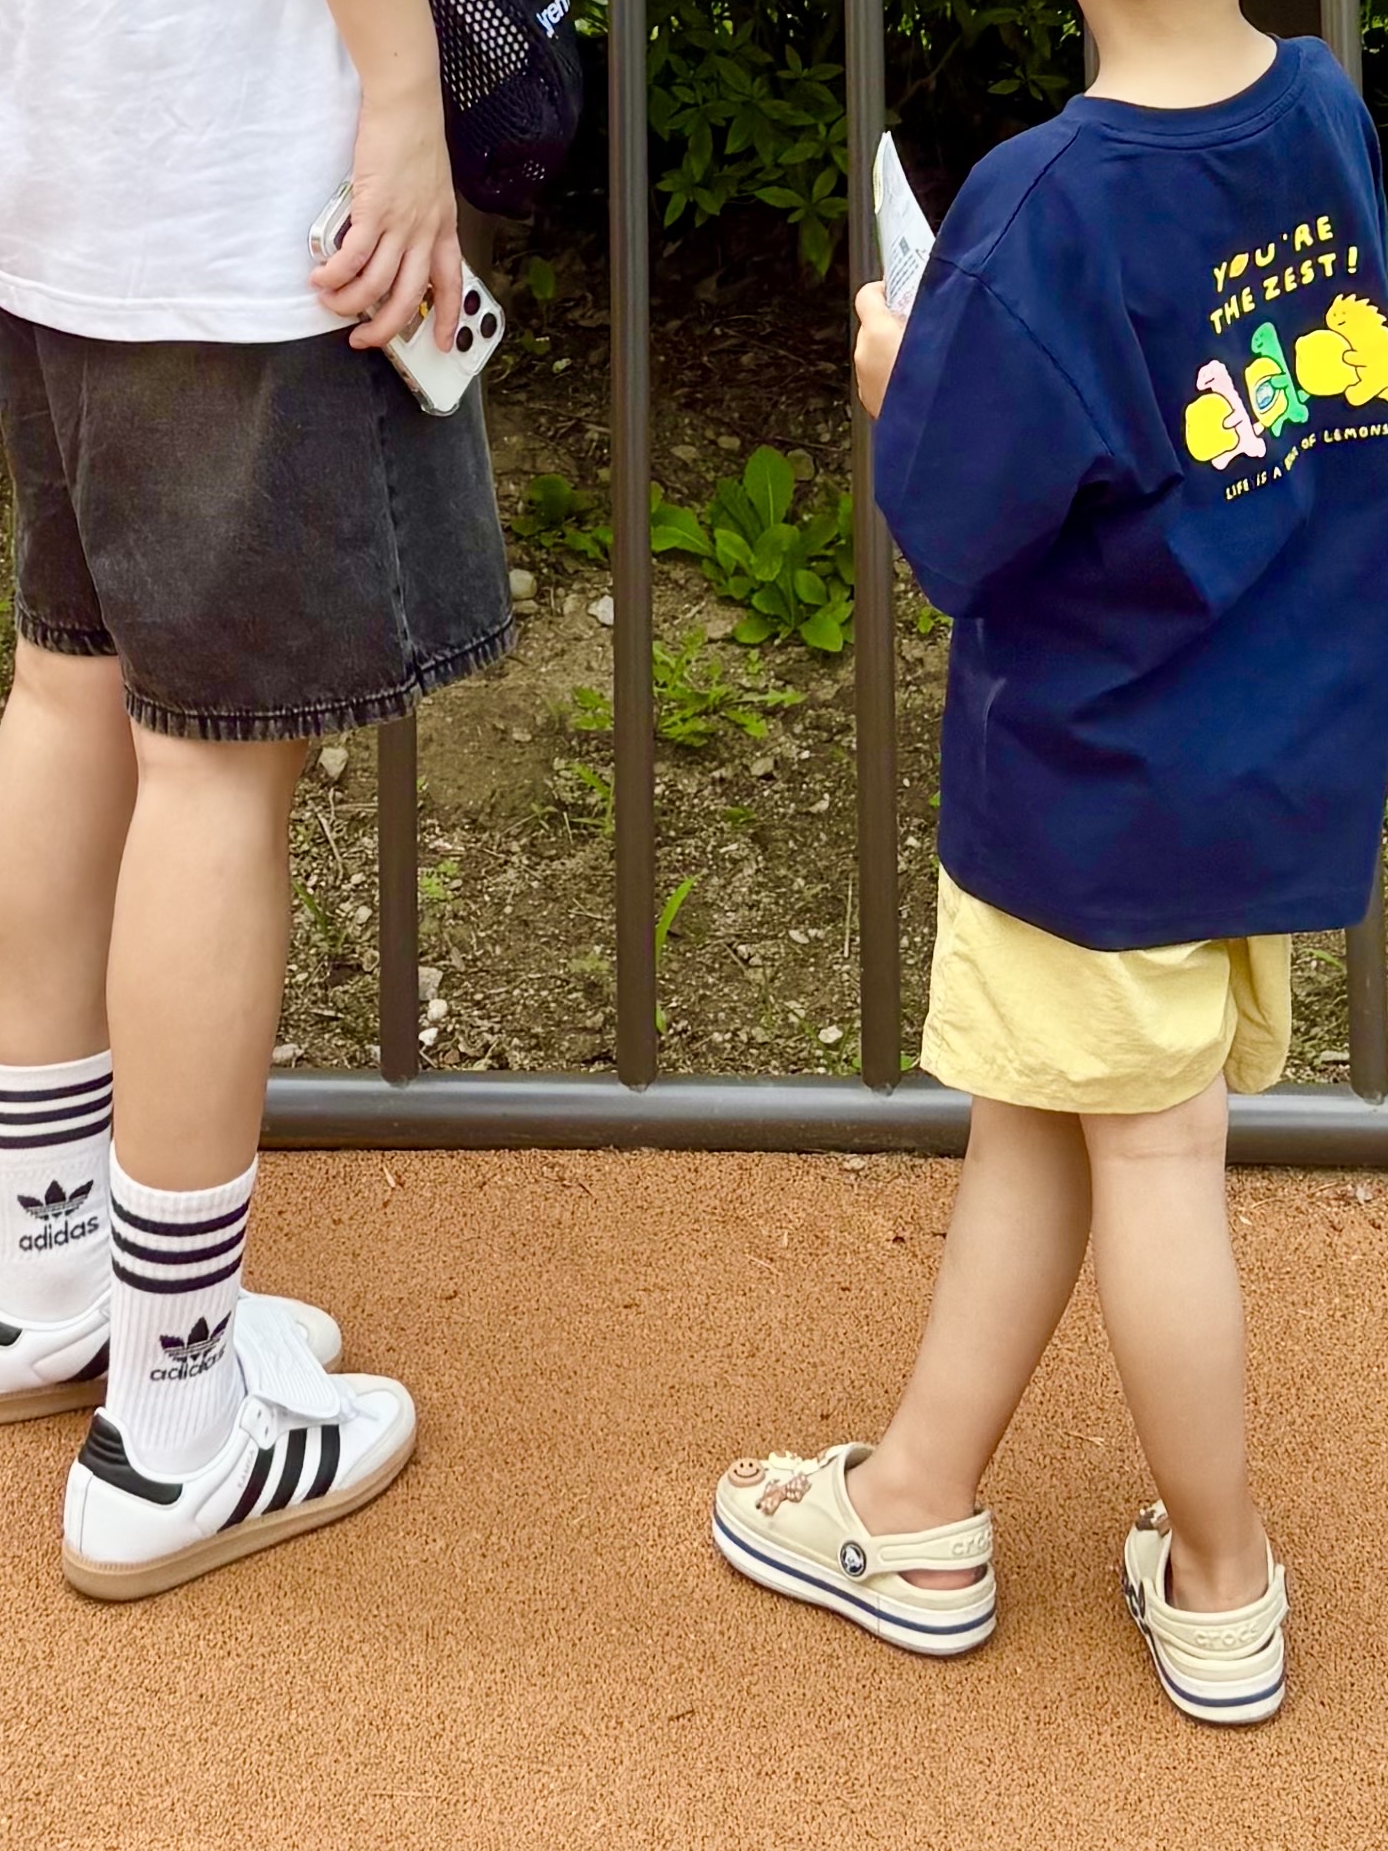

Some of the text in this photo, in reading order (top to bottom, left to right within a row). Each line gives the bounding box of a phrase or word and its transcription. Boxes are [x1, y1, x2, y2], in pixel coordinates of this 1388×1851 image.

[1213, 215, 1334, 293] YOU'RE
[1210, 286, 1256, 335] THE
[1225, 478, 1250, 500] LIFE
[1256, 471, 1268, 486] IS
[1273, 466, 1282, 479] A
[1300, 433, 1316, 450] OF
[18, 1216, 100, 1252] adidas
[1194, 1622, 1258, 1648] crocs
